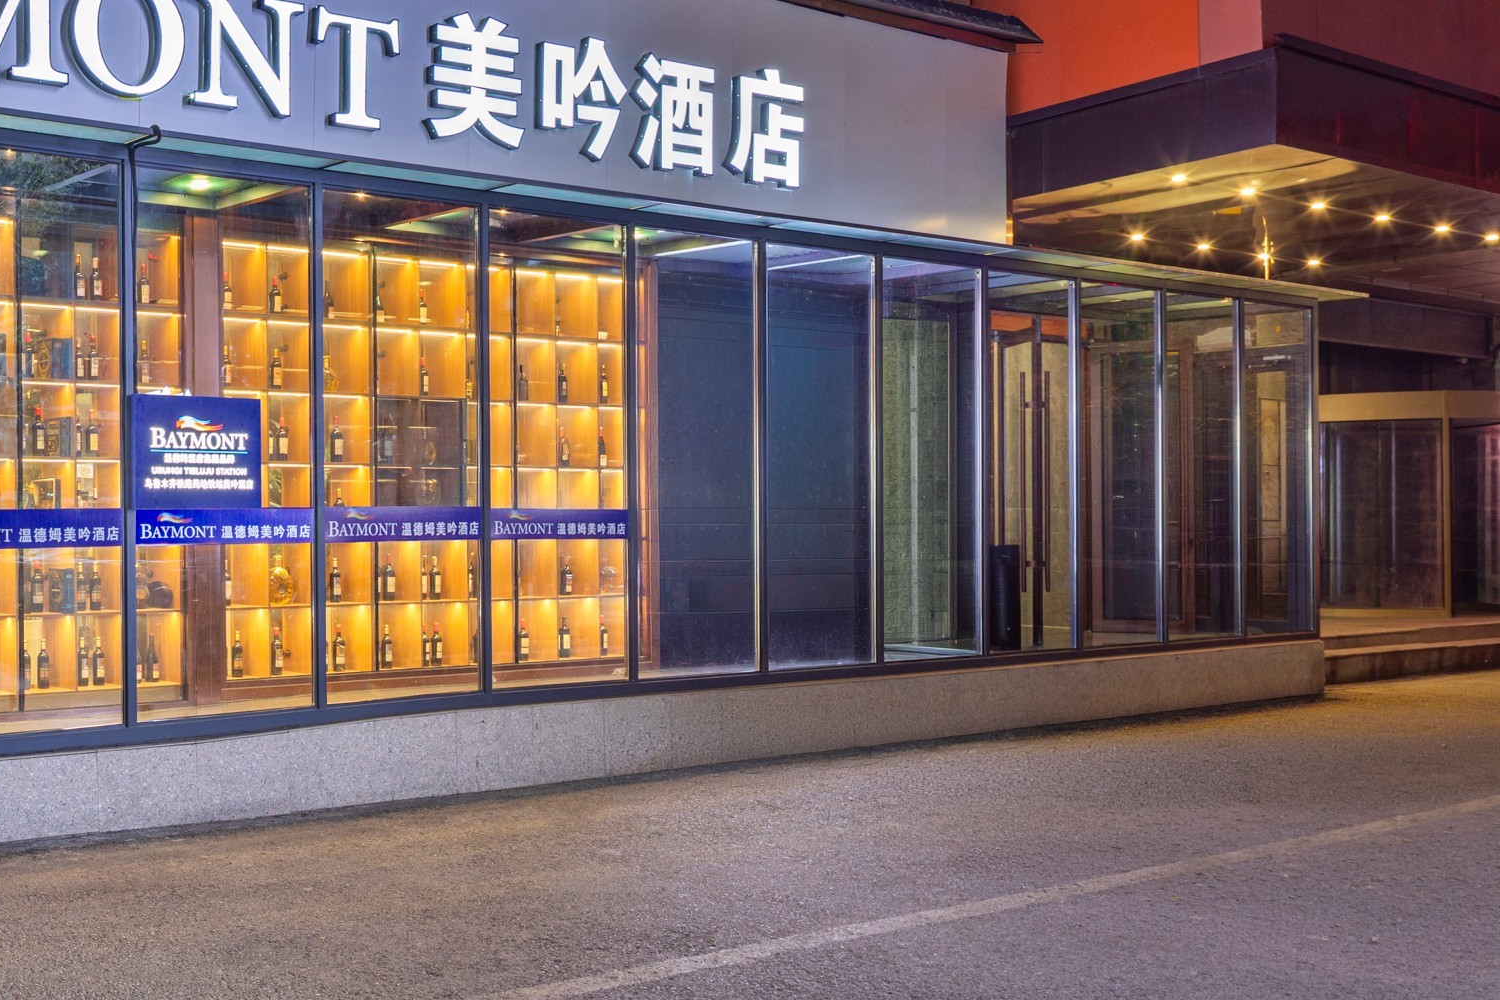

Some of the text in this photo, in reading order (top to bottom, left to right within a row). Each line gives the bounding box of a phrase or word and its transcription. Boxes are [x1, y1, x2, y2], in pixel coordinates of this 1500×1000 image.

[426, 11, 806, 190] 美吟酒店
[149, 427, 249, 451] BAYMONT
[216, 467, 248, 477] STATION
[18, 527, 120, 543] 温德姆美吟酒店
[140, 523, 311, 539] BAYMONT 温德姆美吟酒店
[327, 520, 479, 537] BAYMONT 温德姆美吟酒店
[493, 520, 626, 536] BAYMONT 温德姆美吟酒店
